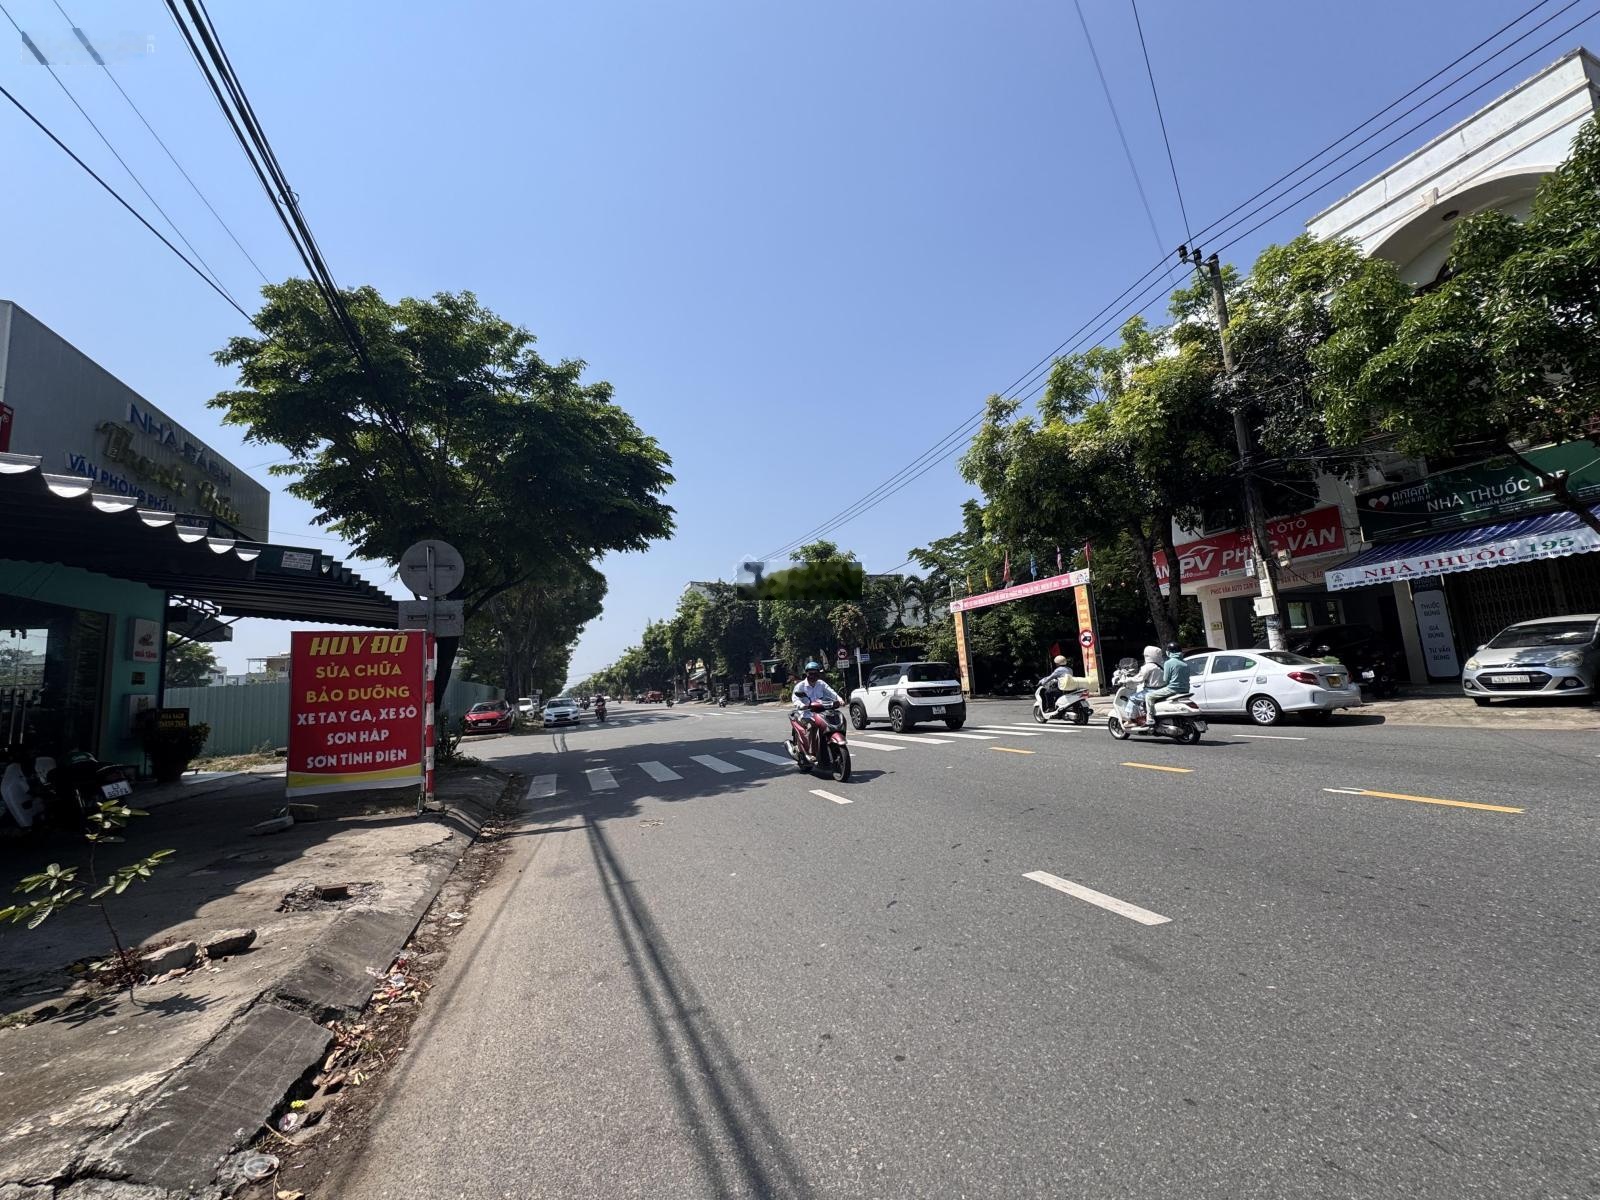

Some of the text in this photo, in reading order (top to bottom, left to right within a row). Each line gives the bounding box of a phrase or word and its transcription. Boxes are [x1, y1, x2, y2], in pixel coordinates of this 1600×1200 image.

[129, 403, 177, 446] NHÀ
[100, 469, 146, 501] PHÒNG
[1427, 494, 1465, 513] NHÀ
[1467, 475, 1531, 503] THUỐC
[1276, 518, 1308, 534] ÔTÔ
[1286, 526, 1337, 552] VÂN
[1179, 552, 1215, 574] PV
[1364, 561, 1415, 579] NHÀ
[1419, 545, 1516, 570] THUỐC
[1527, 536, 1575, 553] 195
[309, 632, 409, 657] HUY ĐỘ
[315, 660, 402, 679] SỬA CHỮA
[306, 684, 410, 704] BẢO DƯỠNG
[297, 713, 316, 726] XE
[319, 711, 347, 725] TAY
[349, 709, 377, 723] GA,
[379, 707, 397, 720] XE
[327, 732, 357, 746] SƠN
[306, 754, 337, 769] SƠN
